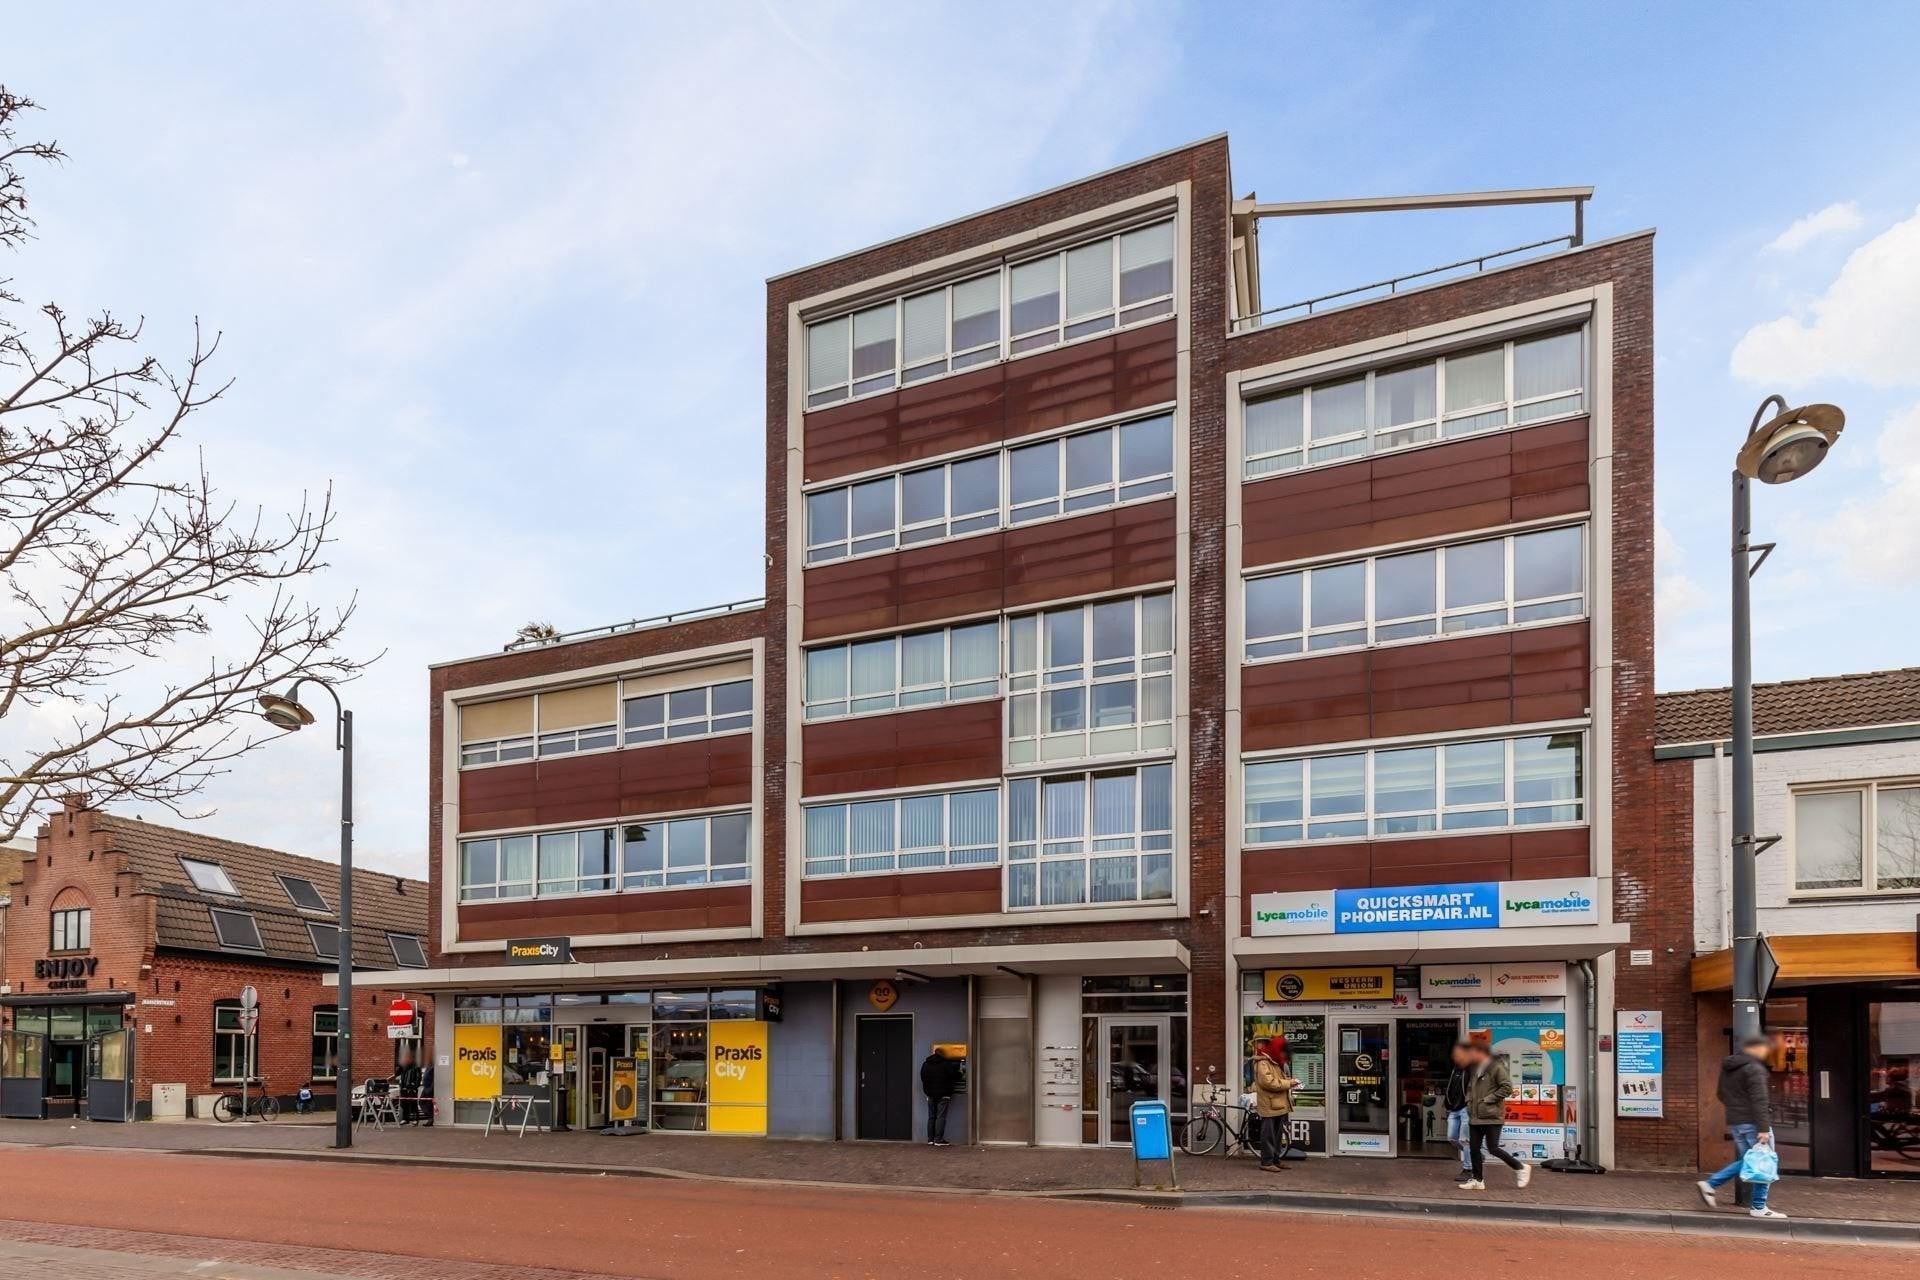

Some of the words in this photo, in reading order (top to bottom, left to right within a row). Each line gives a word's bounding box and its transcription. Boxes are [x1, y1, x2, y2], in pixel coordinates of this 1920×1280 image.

[1357, 892, 1475, 909] QUICKSMART
[1506, 897, 1590, 912] Lycamobile
[1257, 909, 1329, 922] Lycamobile
[1341, 907, 1493, 924] PHONEREPAIR.NL
[511, 943, 559, 957] PraxisCity
[35, 957, 99, 979] ENJOY
[1331, 976, 1374, 984] WESTERN
[1429, 977, 1481, 987] Lycamobile
[459, 1047, 497, 1060] Praxis
[715, 1045, 762, 1060] Praxis
[471, 1062, 497, 1078] City
[715, 1062, 746, 1080] City
